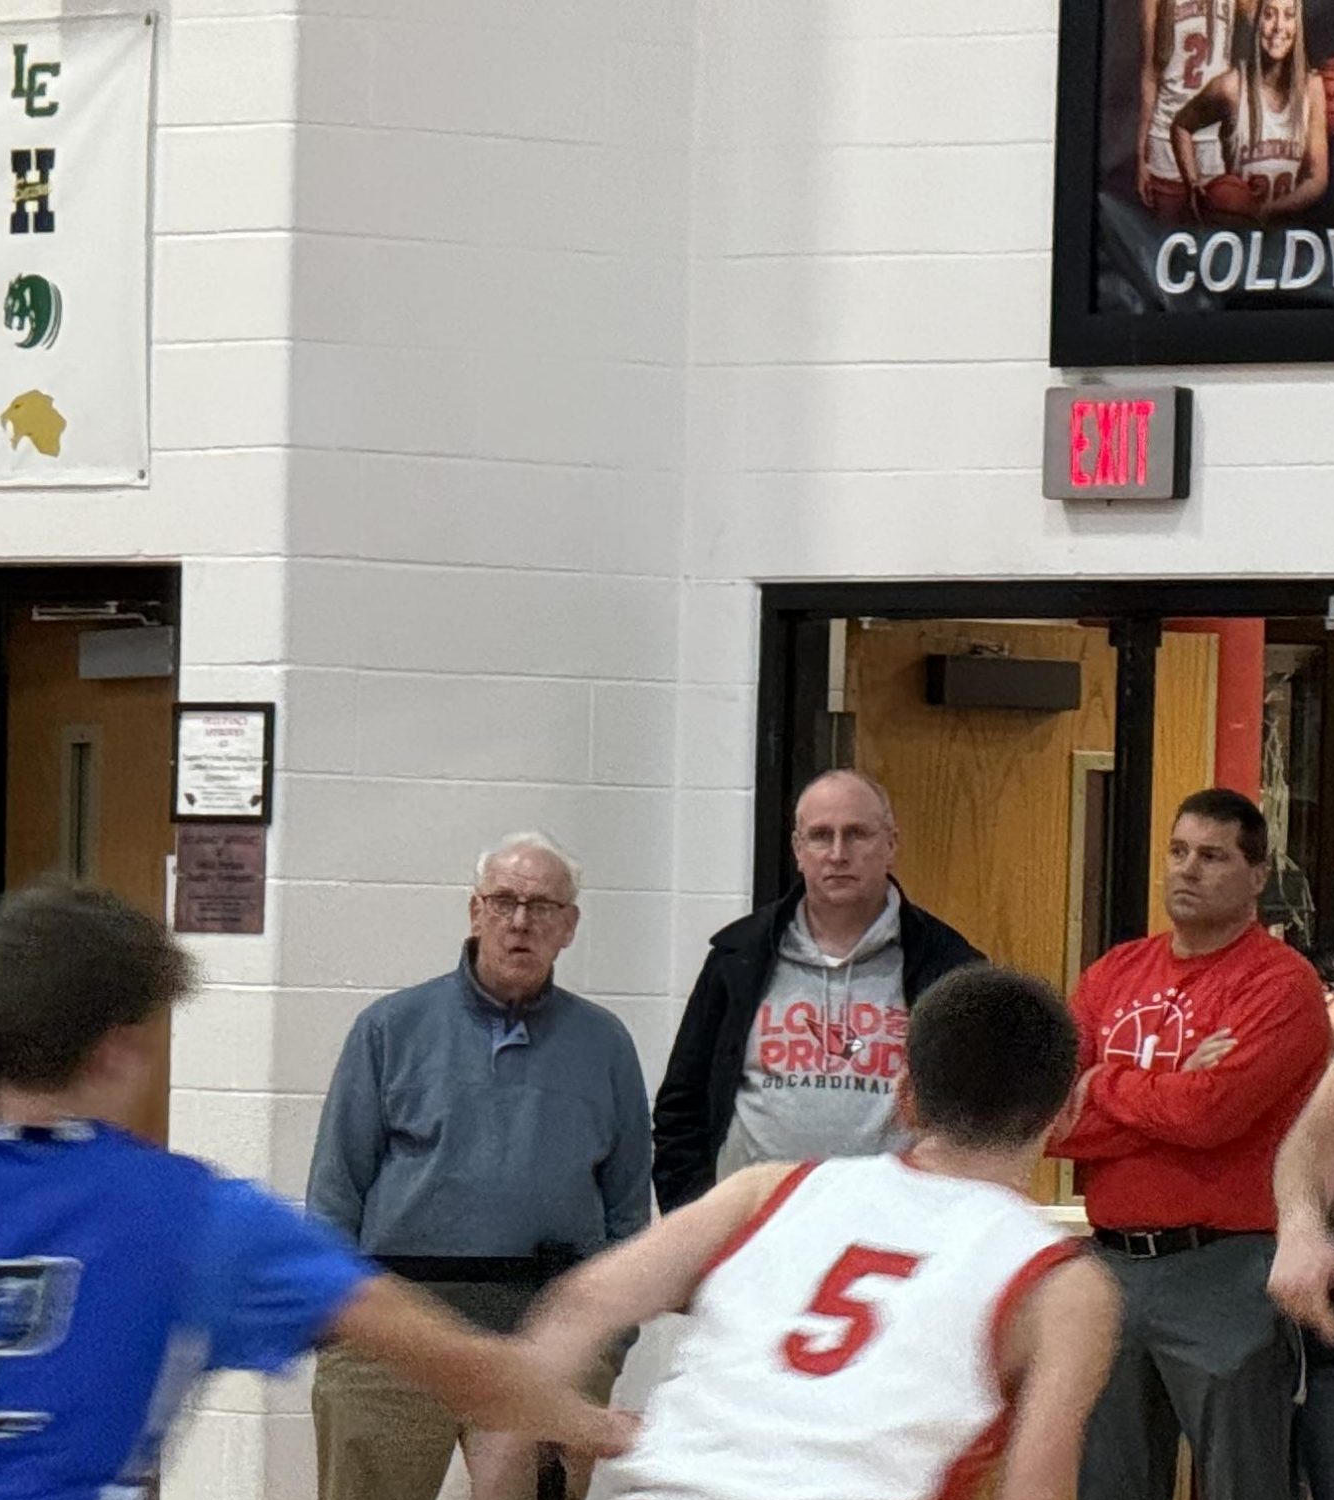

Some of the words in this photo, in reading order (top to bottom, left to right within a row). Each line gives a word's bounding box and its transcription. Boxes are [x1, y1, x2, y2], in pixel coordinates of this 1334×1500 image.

[1183, 32, 1208, 89] 2
[10, 148, 55, 234] H
[1070, 400, 1155, 487] EXIT
[760, 1039, 904, 1078] PROUD
[781, 1243, 925, 1378] 5
